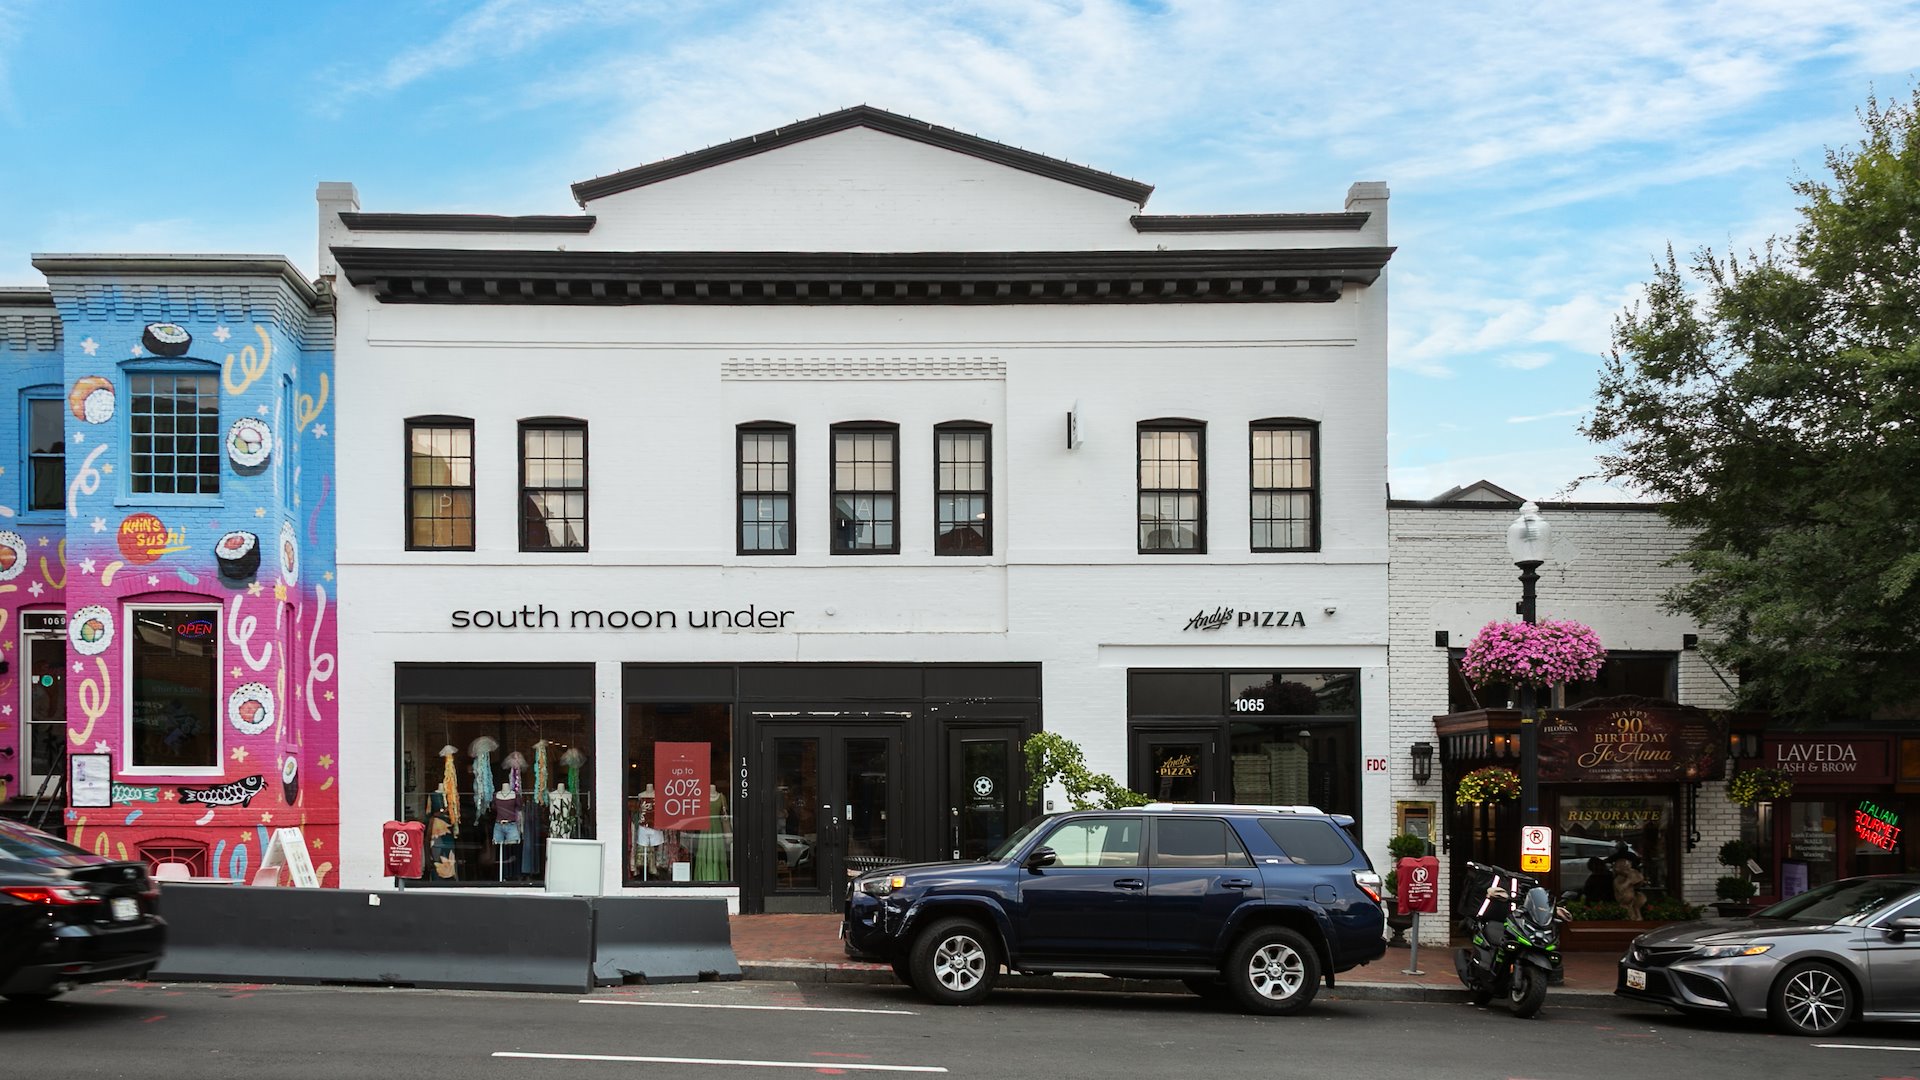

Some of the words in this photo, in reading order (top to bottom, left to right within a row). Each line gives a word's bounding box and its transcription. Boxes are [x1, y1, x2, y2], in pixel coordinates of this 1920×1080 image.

[43, 617, 66, 625] 1069
[451, 604, 559, 628] south
[570, 610, 677, 628] moon
[688, 604, 795, 628] under
[1183, 606, 1234, 631] Andy's
[1237, 611, 1306, 627] PIZZA
[177, 623, 213, 635] OPEN
[1233, 698, 1265, 711] 1065
[1610, 709, 1649, 720] HAPPY
[1543, 724, 1578, 733] FILOMENA
[1616, 717, 1643, 734] 90
[1594, 733, 1668, 743] BIRTHDAY
[1777, 744, 1857, 761] LAVEDA
[1162, 754, 1191, 768] Andy's
[1366, 758, 1387, 771] FDC
[1777, 762, 1805, 772] LASH
[1807, 762, 1818, 772] &
[1821, 762, 1857, 772] BROW
[671, 768, 683, 776] up
[685, 767, 694, 775] to
[1160, 767, 1192, 776] PIZZA
[664, 778, 702, 797] 60%
[664, 798, 701, 816] OFF
[1858, 800, 1898, 825] ITALIAN
[1567, 810, 1661, 821] RISTORANTE
[1855, 824, 1898, 852] MARKET
